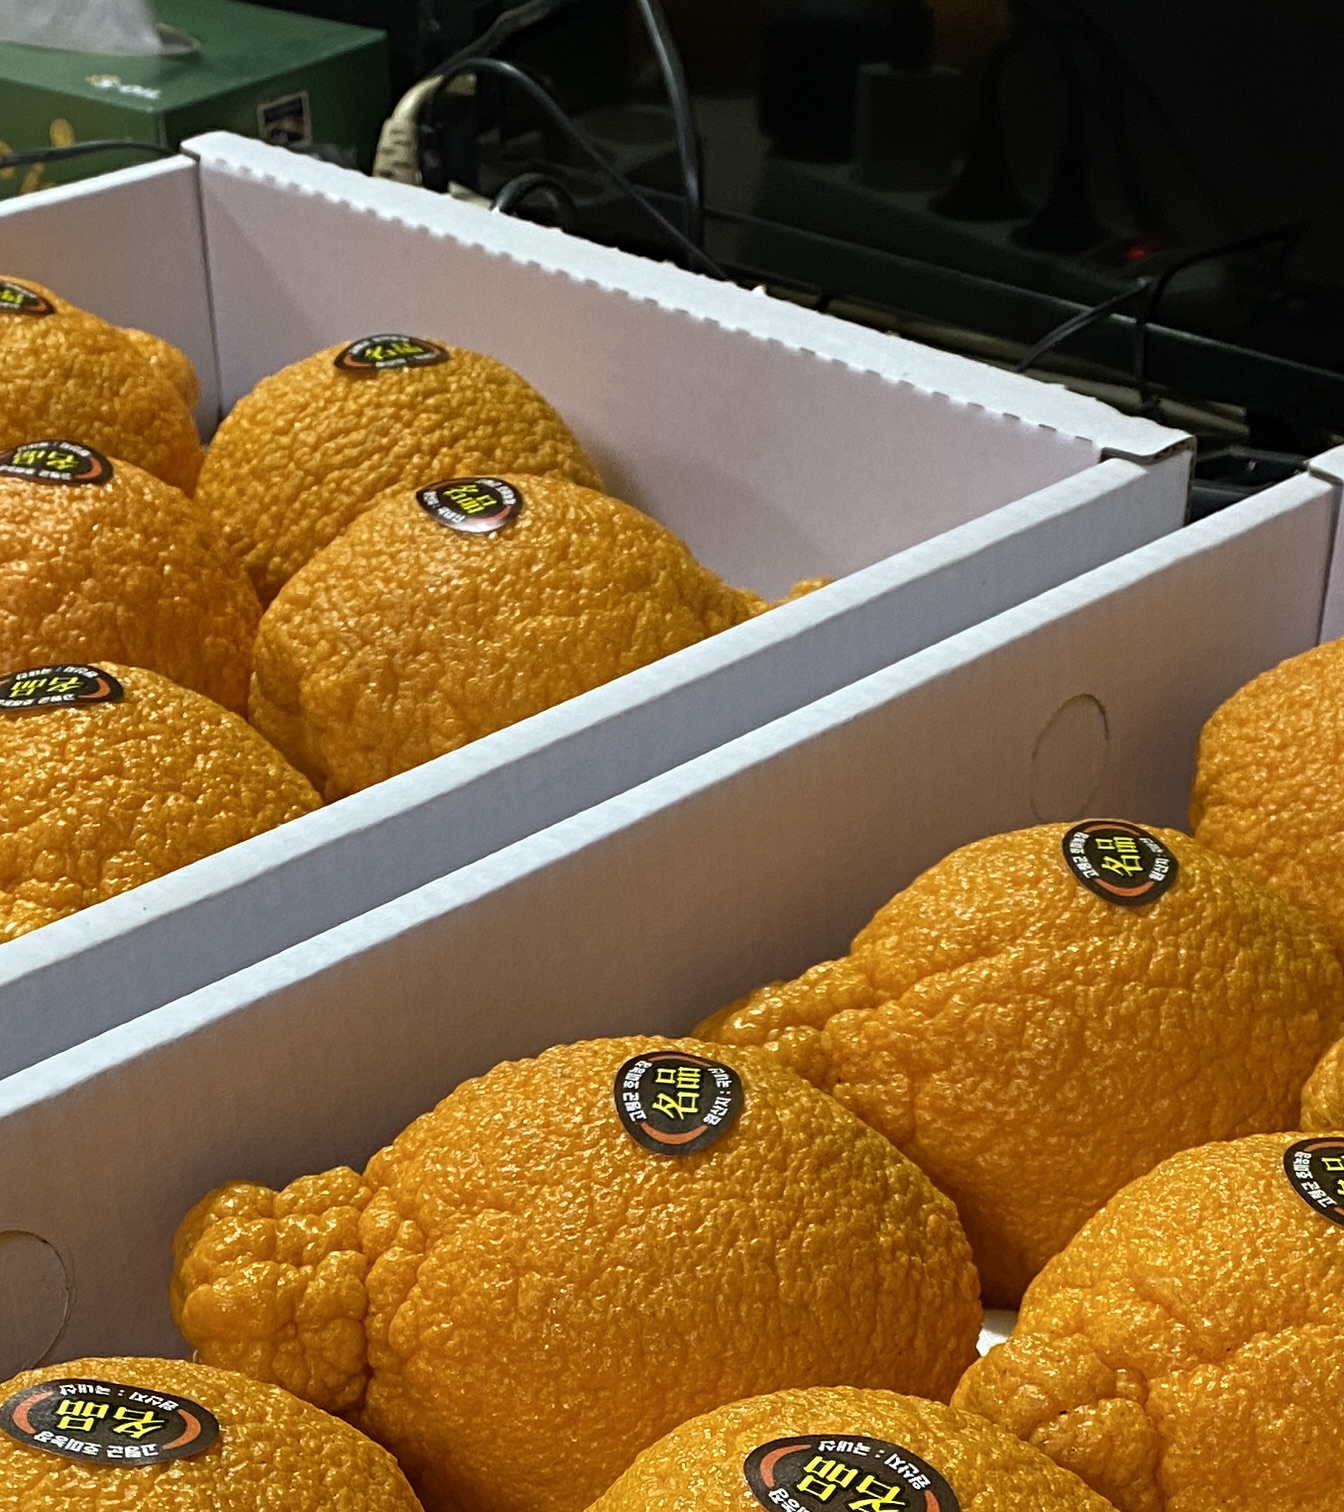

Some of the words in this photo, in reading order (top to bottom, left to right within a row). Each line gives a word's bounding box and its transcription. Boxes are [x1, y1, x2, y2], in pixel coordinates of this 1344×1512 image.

[9, 677, 83, 698] 名品
[1098, 837, 1144, 877] 名品
[652, 1067, 701, 1120] 名品
[59, 1385, 111, 1396] 국내산
[129, 1391, 179, 1409] 원산지
[56, 1400, 166, 1439] 名品
[34, 1431, 100, 1455] 호미농장
[107, 1445, 160, 1458] 고령군
[818, 1441, 872, 1457] 국내산
[884, 1454, 931, 1490] 원산지
